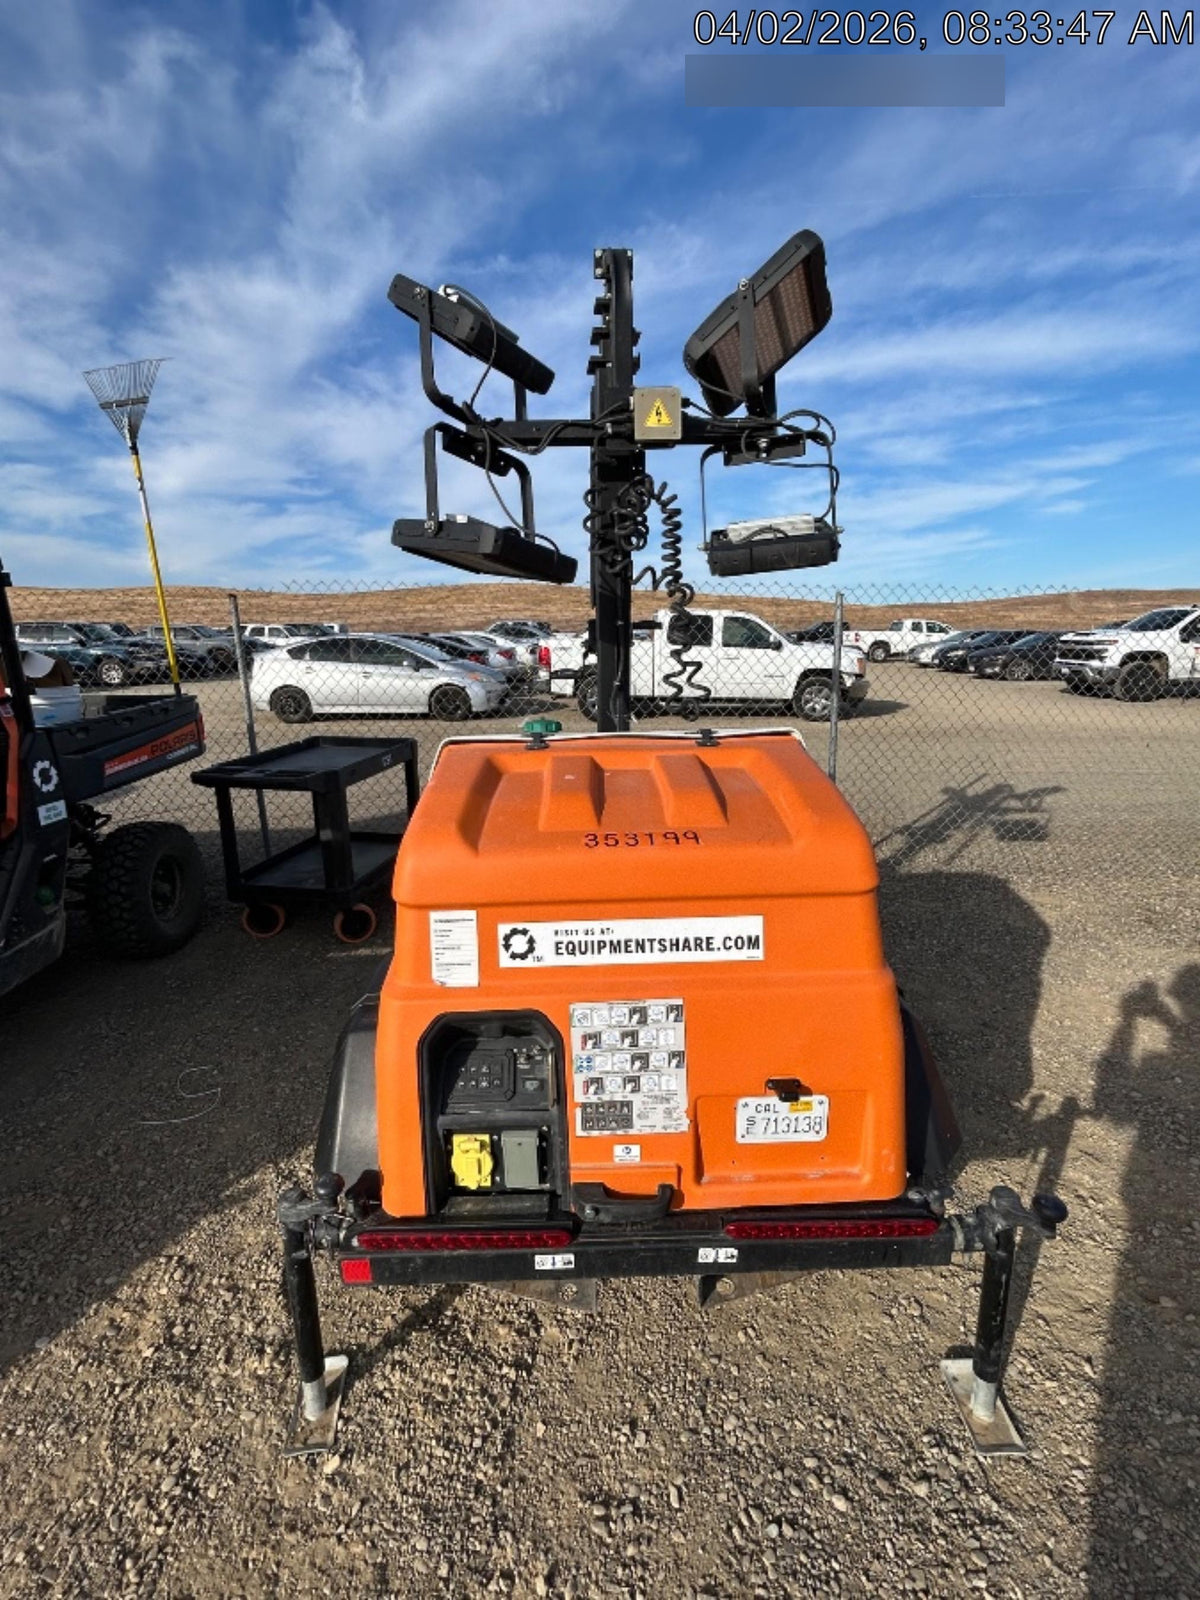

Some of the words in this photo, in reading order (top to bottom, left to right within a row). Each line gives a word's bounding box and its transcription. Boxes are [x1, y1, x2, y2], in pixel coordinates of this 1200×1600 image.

[150, 729, 196, 755] POLARIS
[584, 829, 701, 848] 353199
[554, 935, 761, 957] EQUIPMENTSHARE.COM
[755, 1103, 780, 1114] CAL
